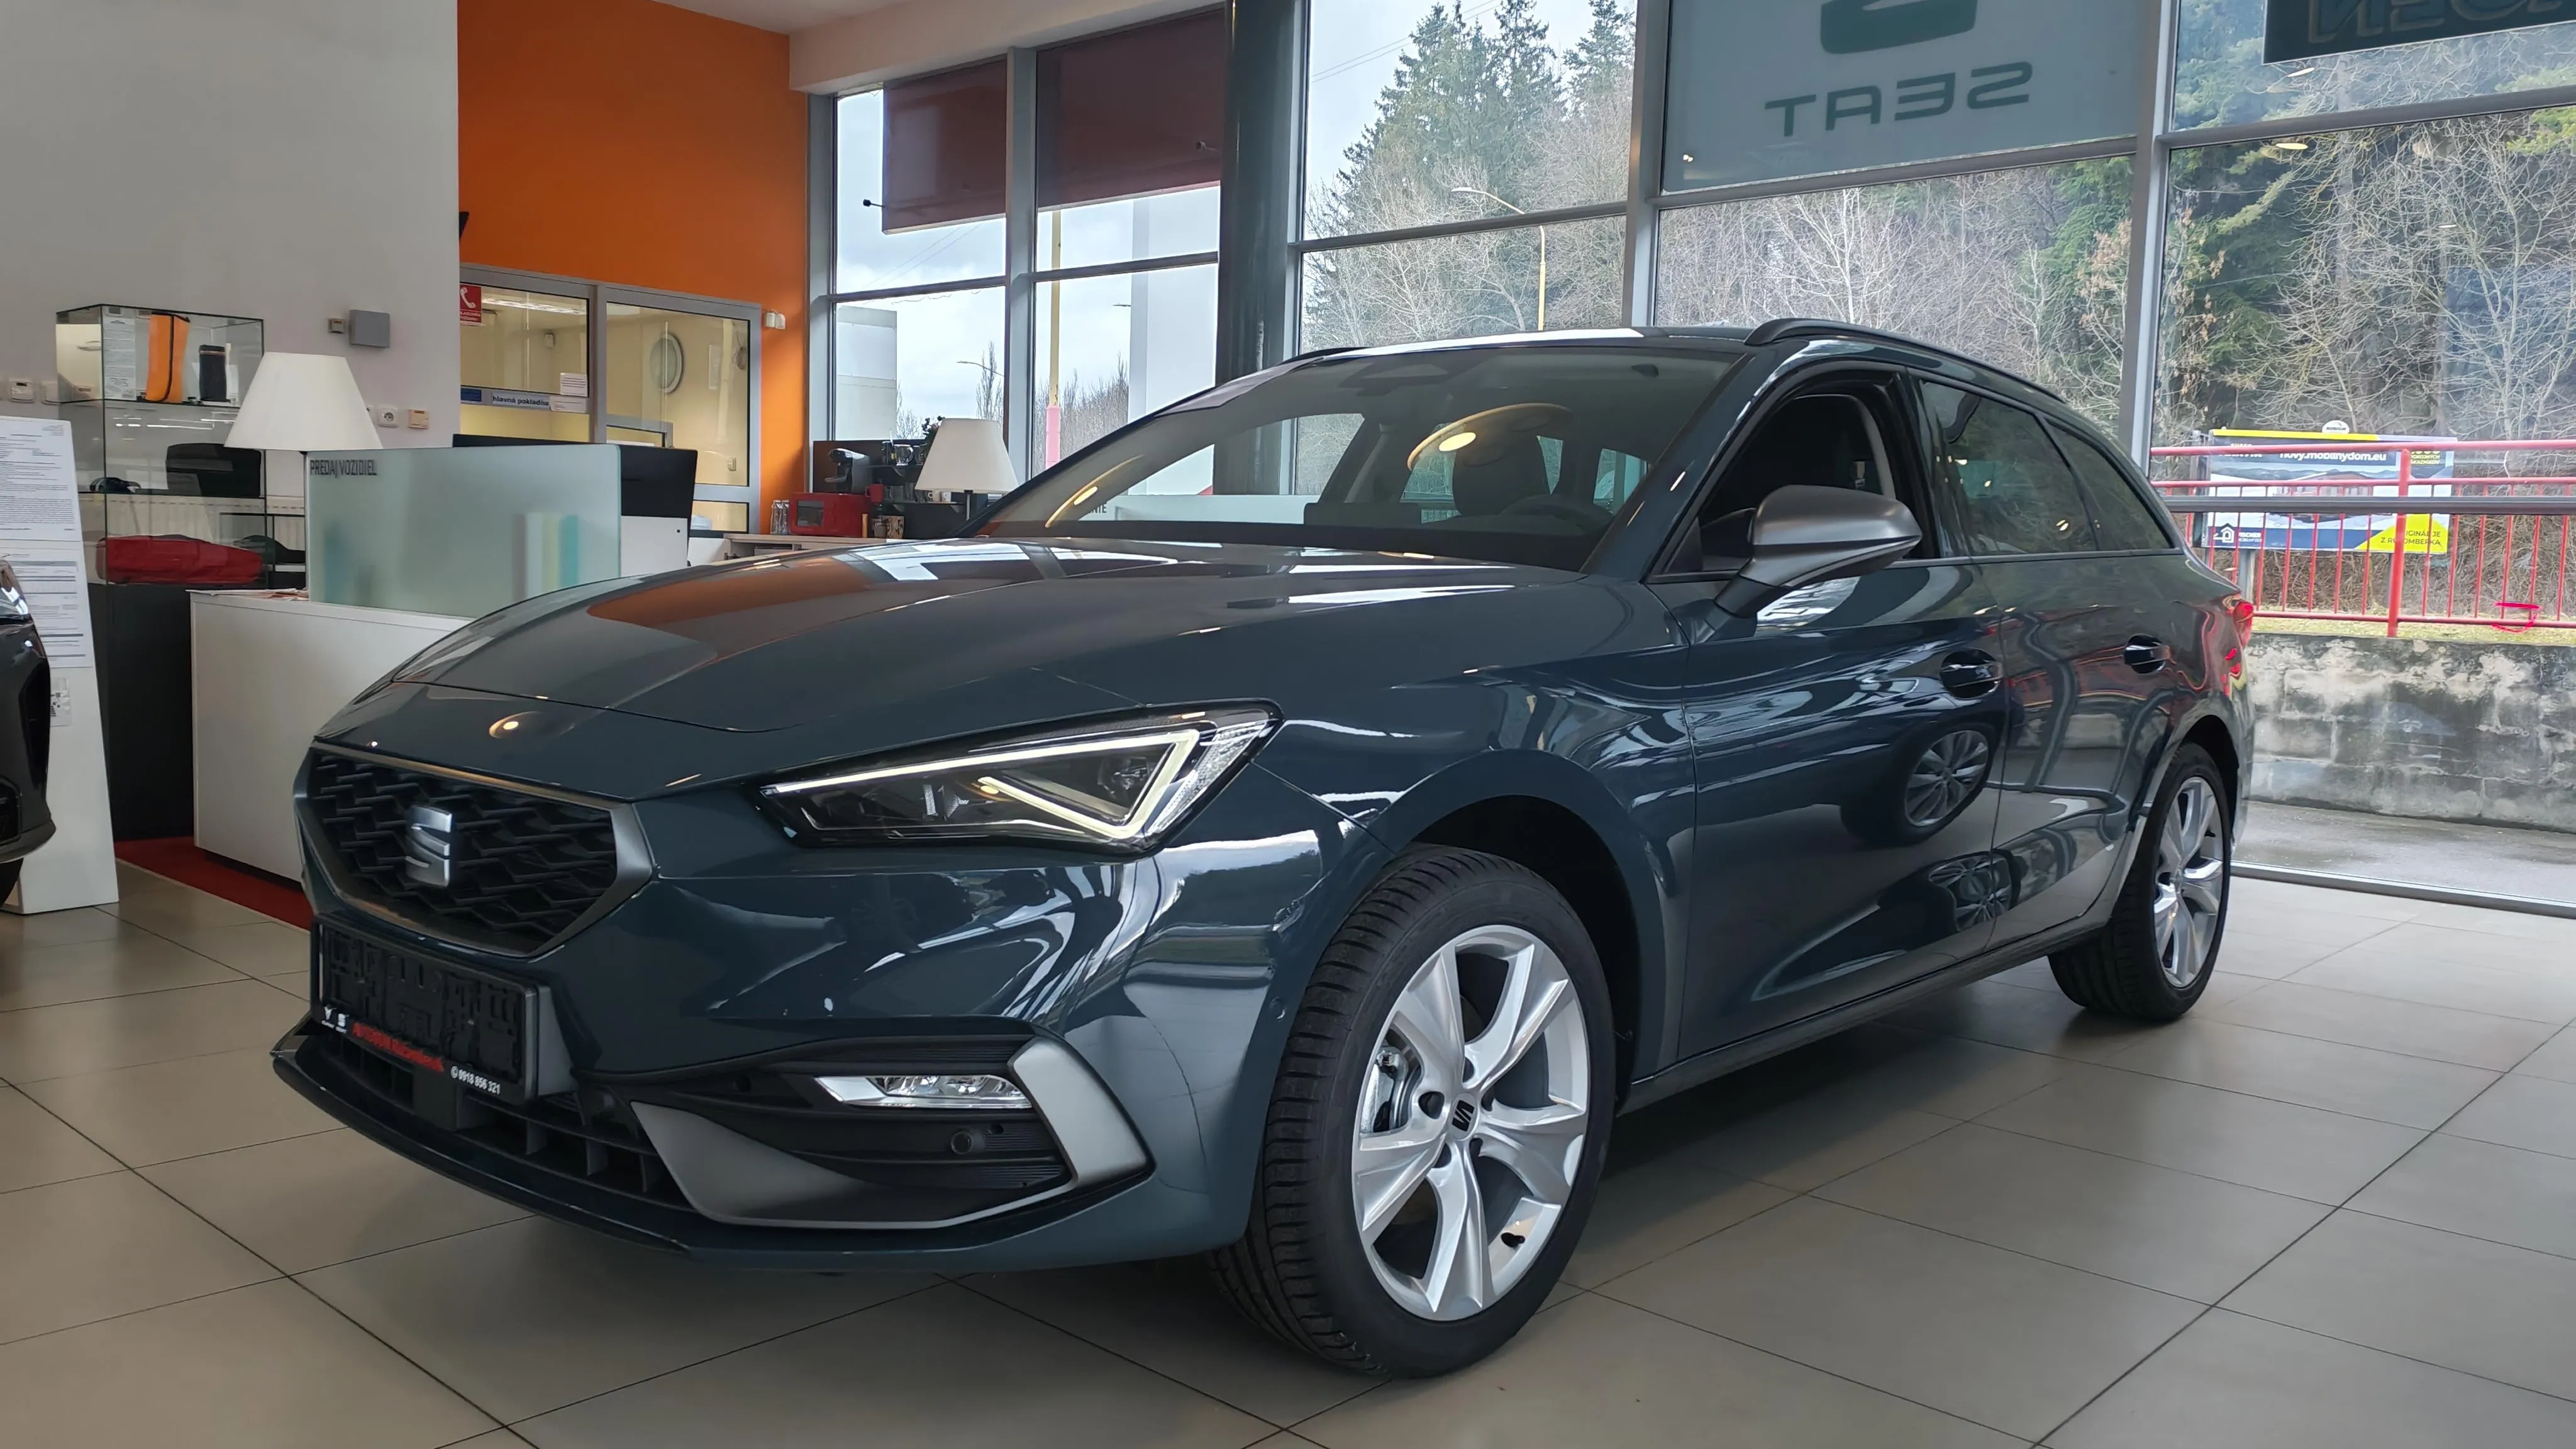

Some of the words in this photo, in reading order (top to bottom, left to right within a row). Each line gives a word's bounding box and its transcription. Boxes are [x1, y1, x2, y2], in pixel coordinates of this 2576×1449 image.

[310, 460, 338, 479] PREDAJ
[340, 460, 377, 475] VOZIDIEL
[488, 1080, 501, 1095] 321
